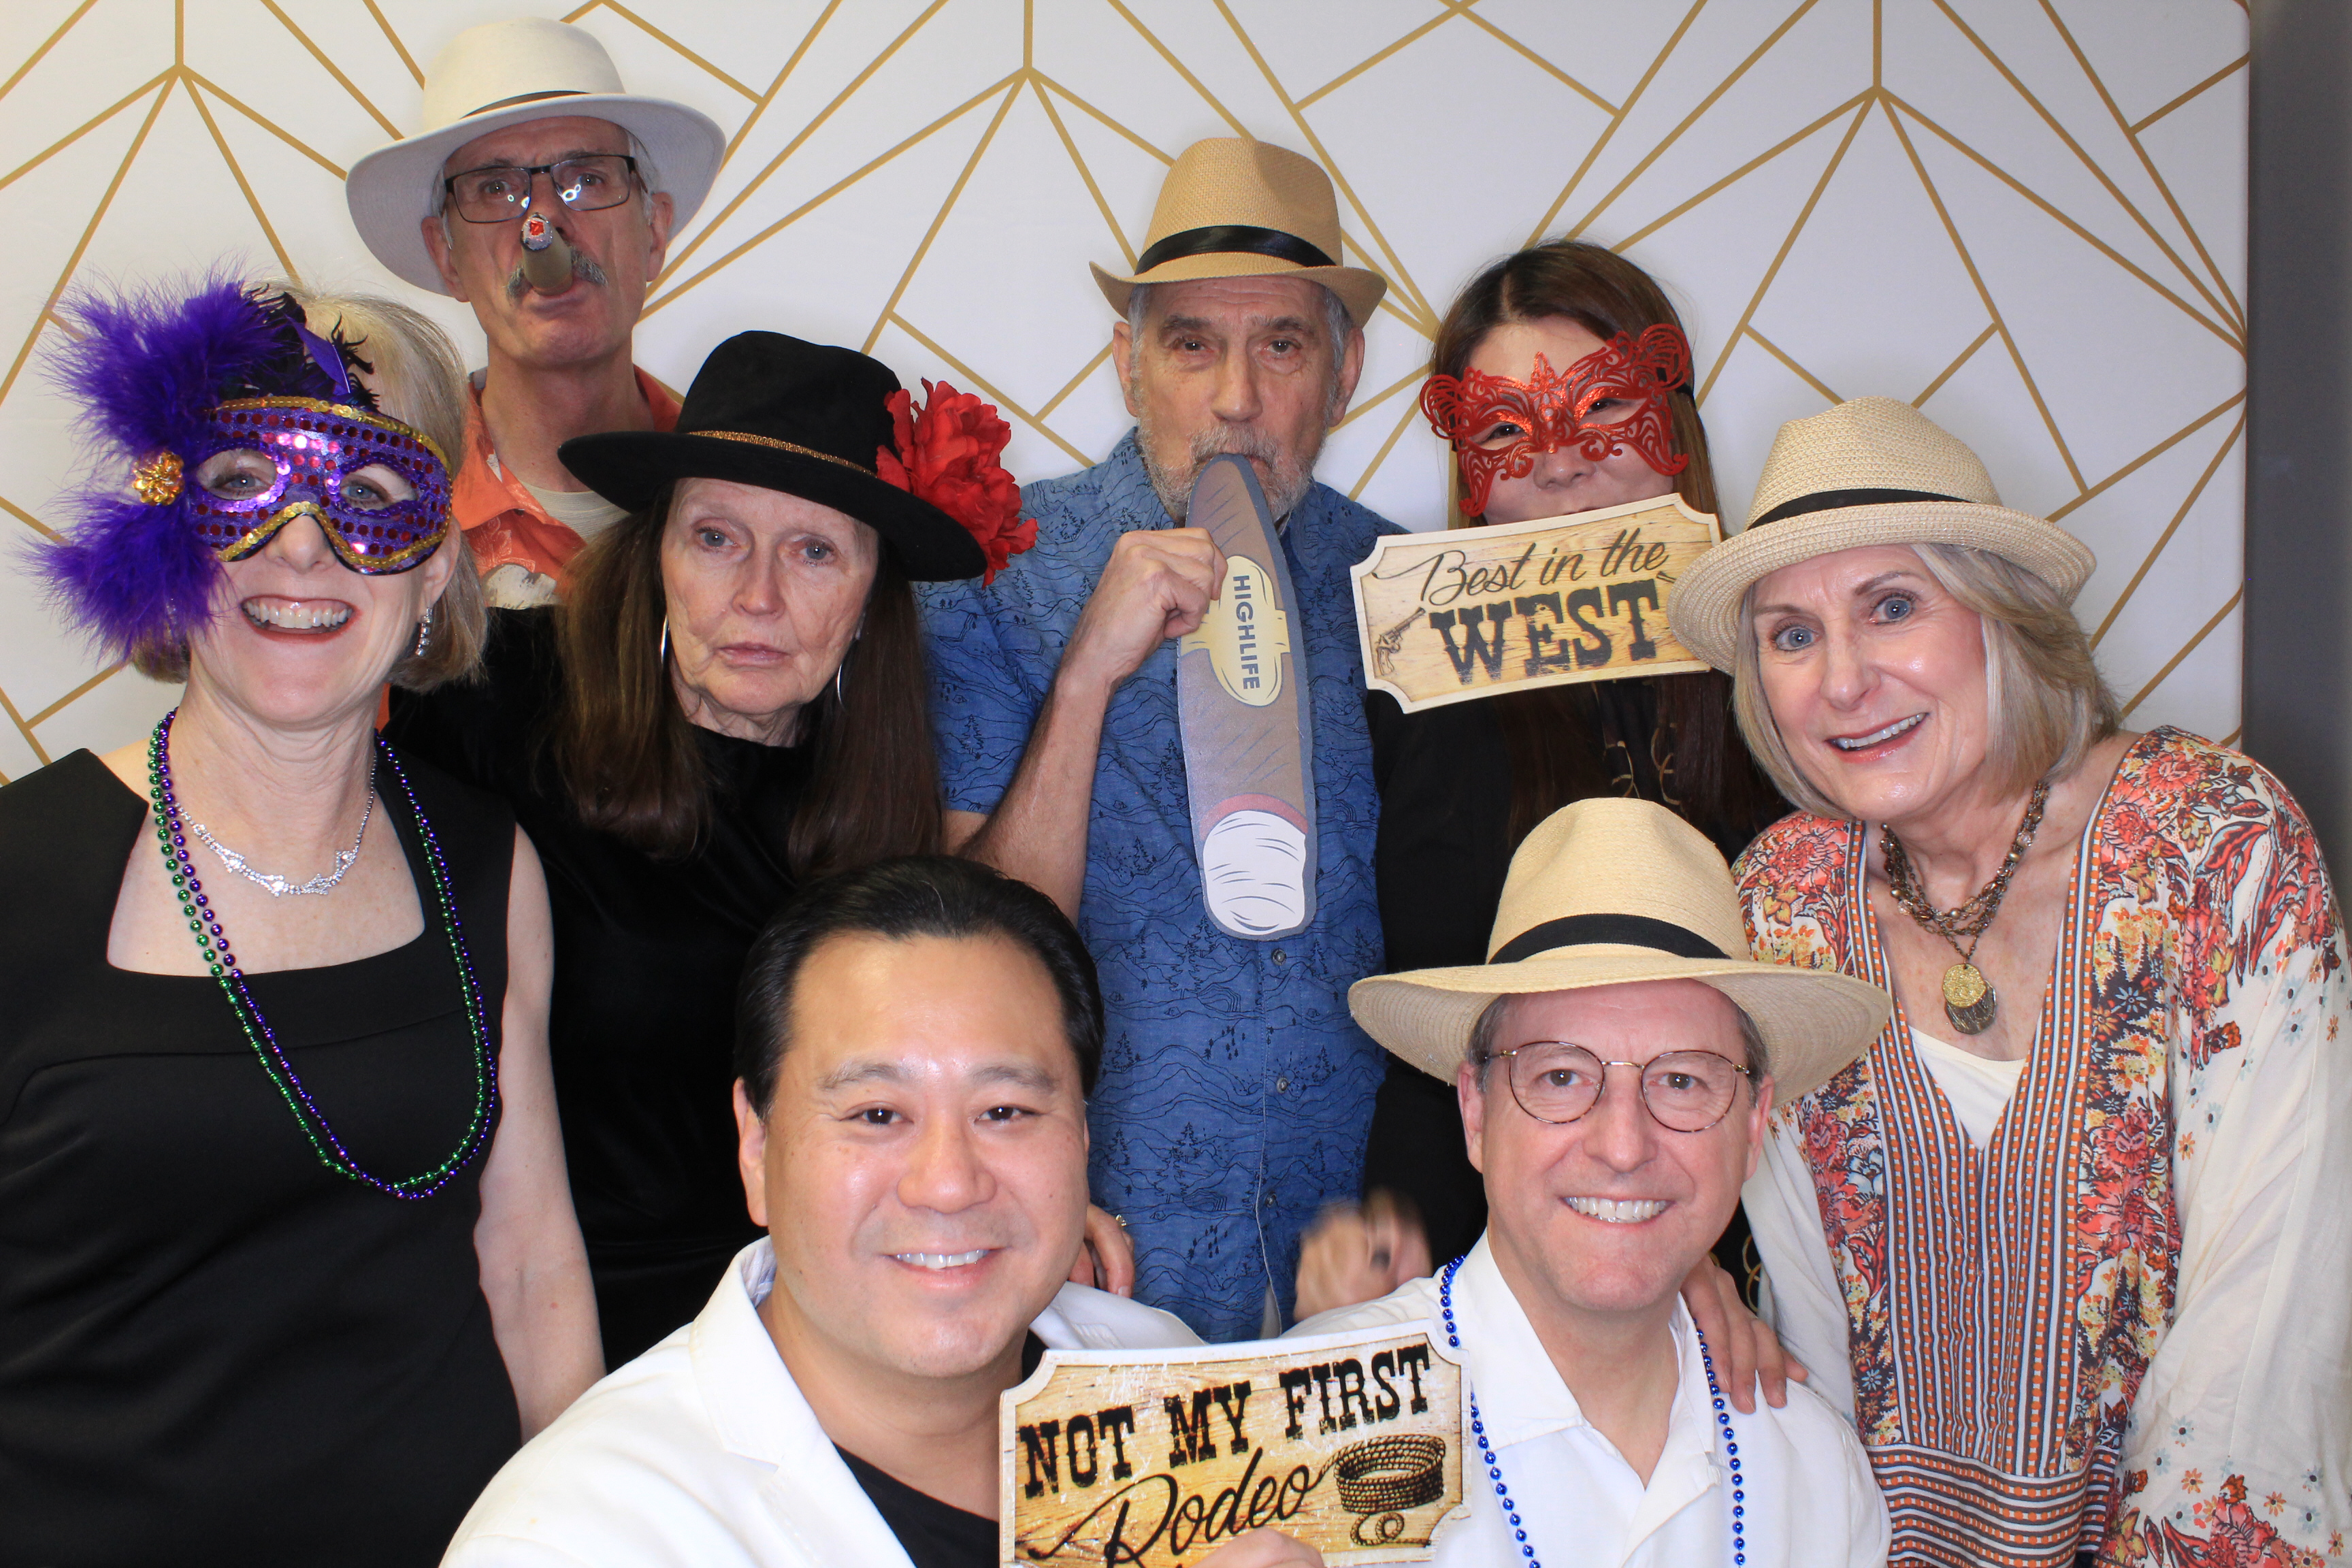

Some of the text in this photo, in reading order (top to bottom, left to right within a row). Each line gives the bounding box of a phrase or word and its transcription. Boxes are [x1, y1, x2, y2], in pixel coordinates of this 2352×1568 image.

[1372, 527, 1669, 606] Best in the
[1232, 575, 1260, 689] HIGHLIFE
[1429, 578, 1661, 685] WEST
[1019, 1343, 1430, 1499] NOT MY FIRST
[1027, 1447, 1319, 1568] Rodeo
